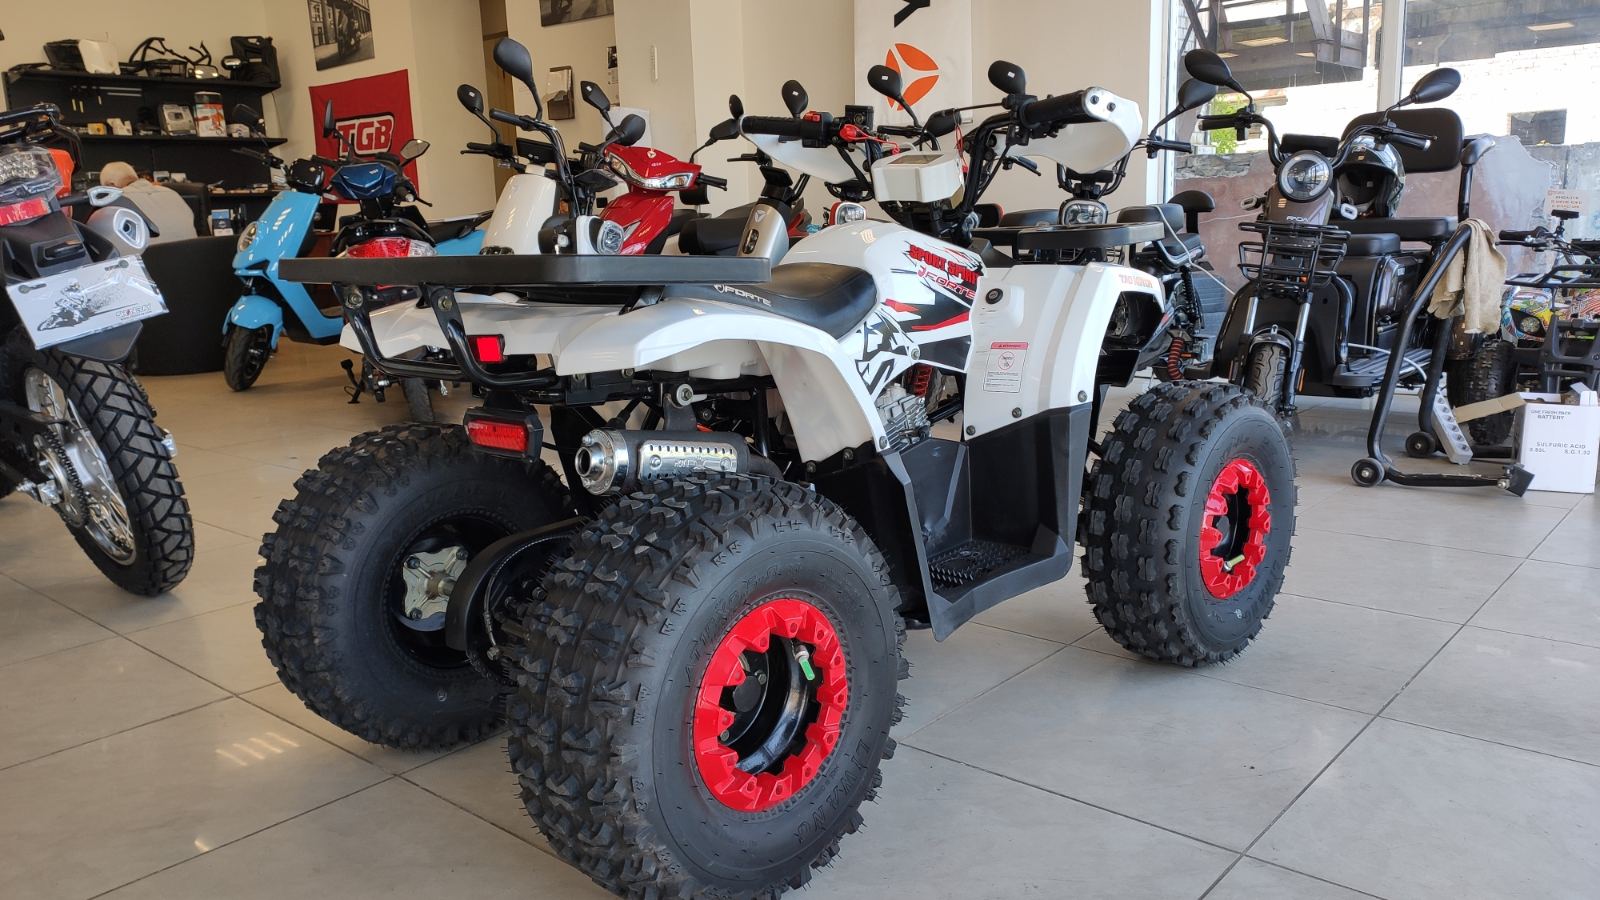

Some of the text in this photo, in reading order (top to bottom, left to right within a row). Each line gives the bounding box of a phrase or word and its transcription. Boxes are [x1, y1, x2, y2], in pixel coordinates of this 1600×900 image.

[336, 115, 394, 157] TGB
[909, 244, 947, 271] SPORT
[724, 285, 771, 307] FORTE
[926, 271, 976, 300] FORTE
